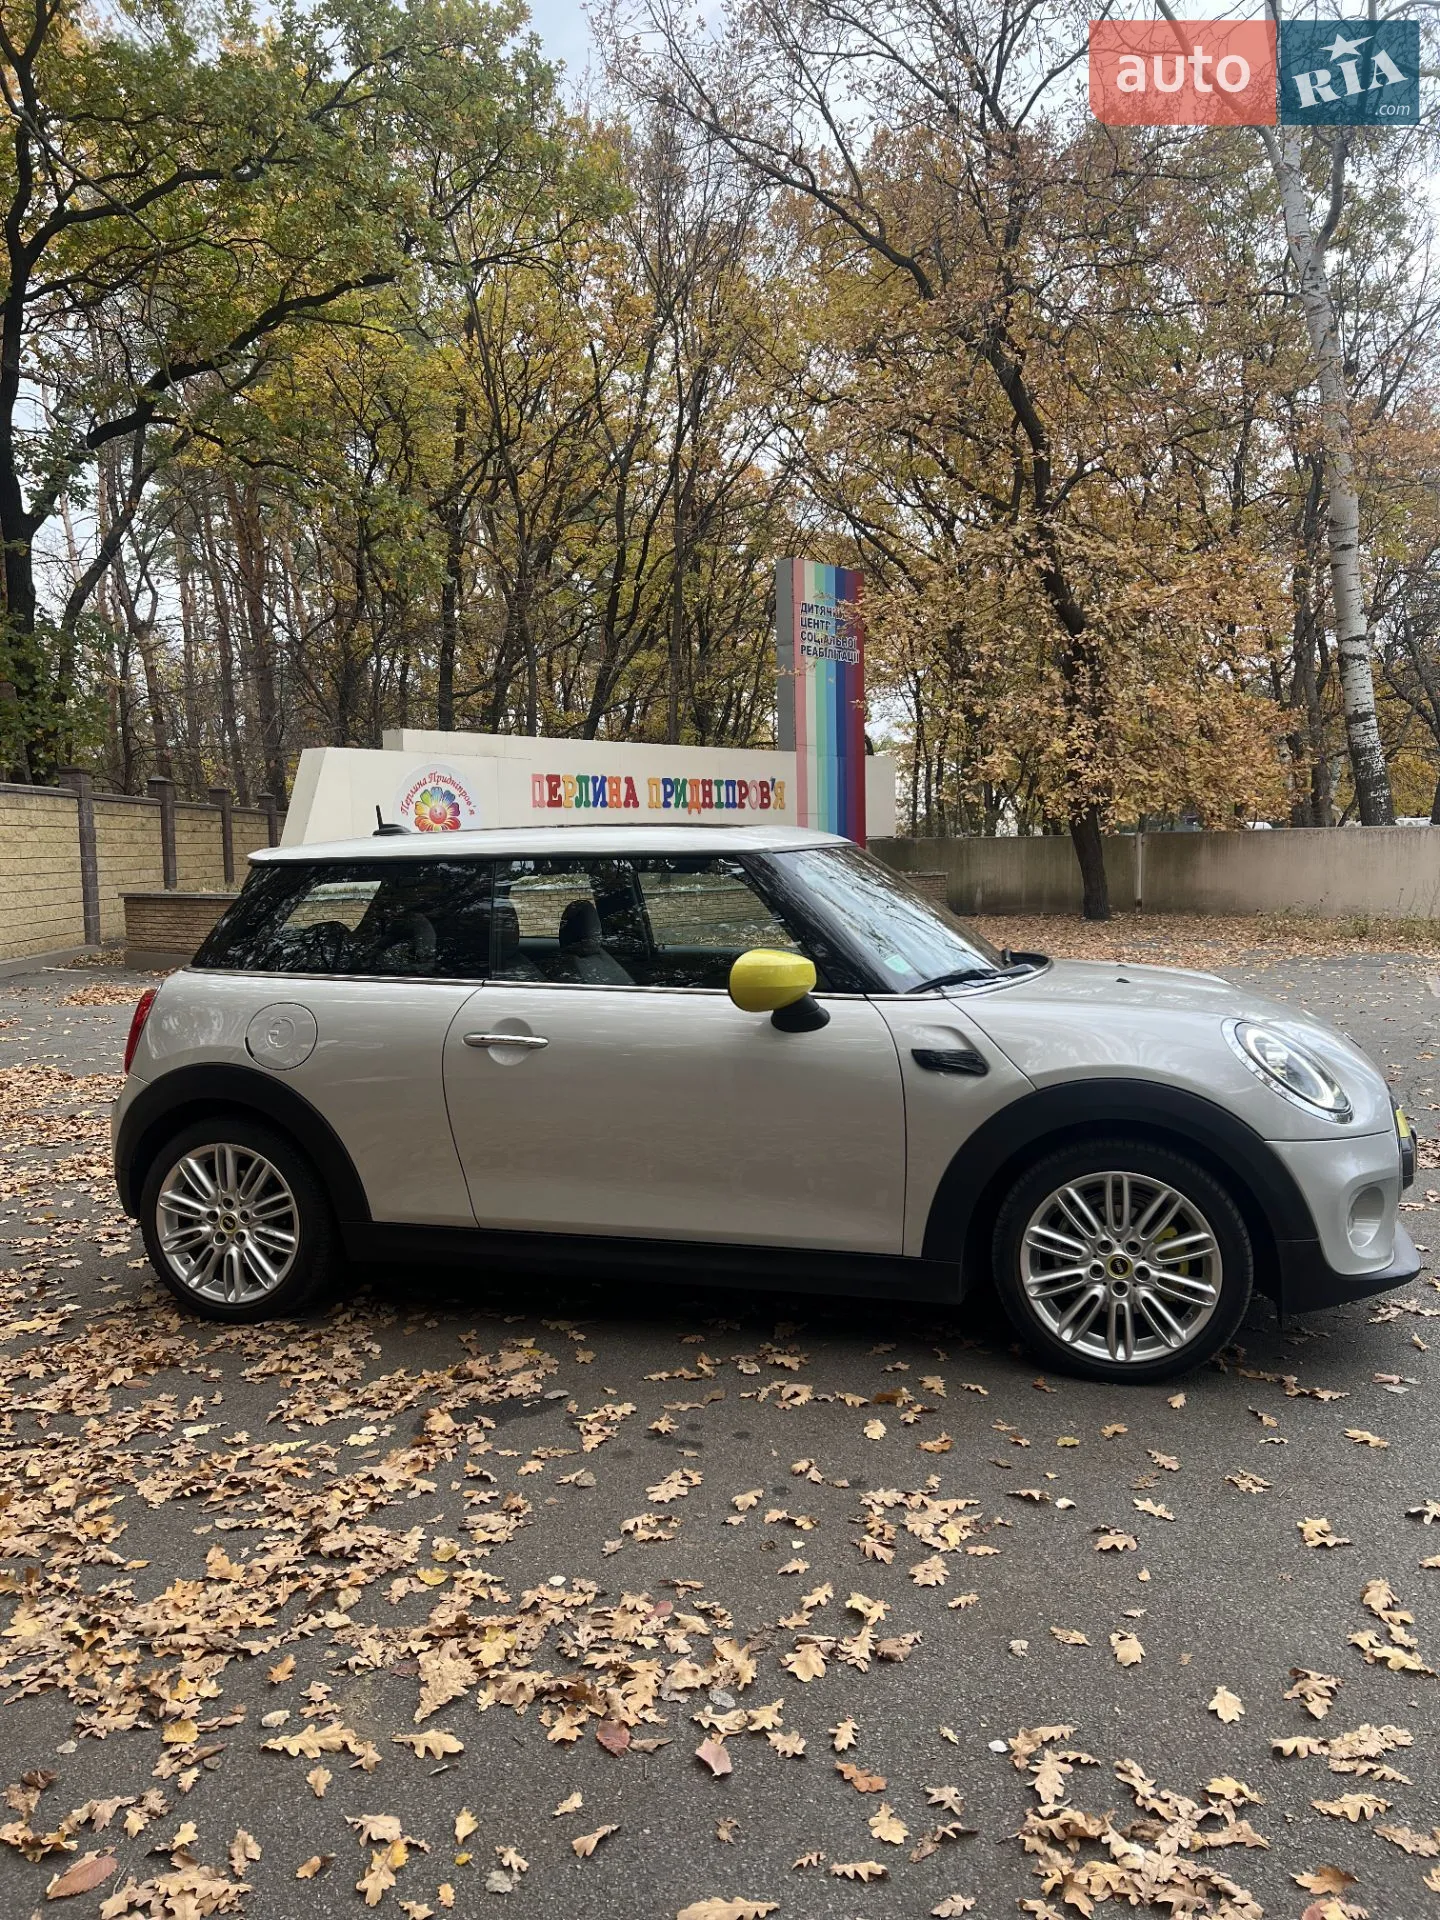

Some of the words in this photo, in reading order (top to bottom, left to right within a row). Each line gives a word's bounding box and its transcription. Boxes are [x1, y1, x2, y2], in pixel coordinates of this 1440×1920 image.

[800, 602, 846, 618] ДИТЯЧ
[800, 616, 831, 631] ЦЕНТР
[800, 645, 860, 664] РЕАБІЛІТАЦІЇ
[400, 777, 428, 816] Перлина
[531, 773, 640, 808] ПЕРЛИНА
[648, 777, 786, 814] ПРИДНІПРОВ'Я
